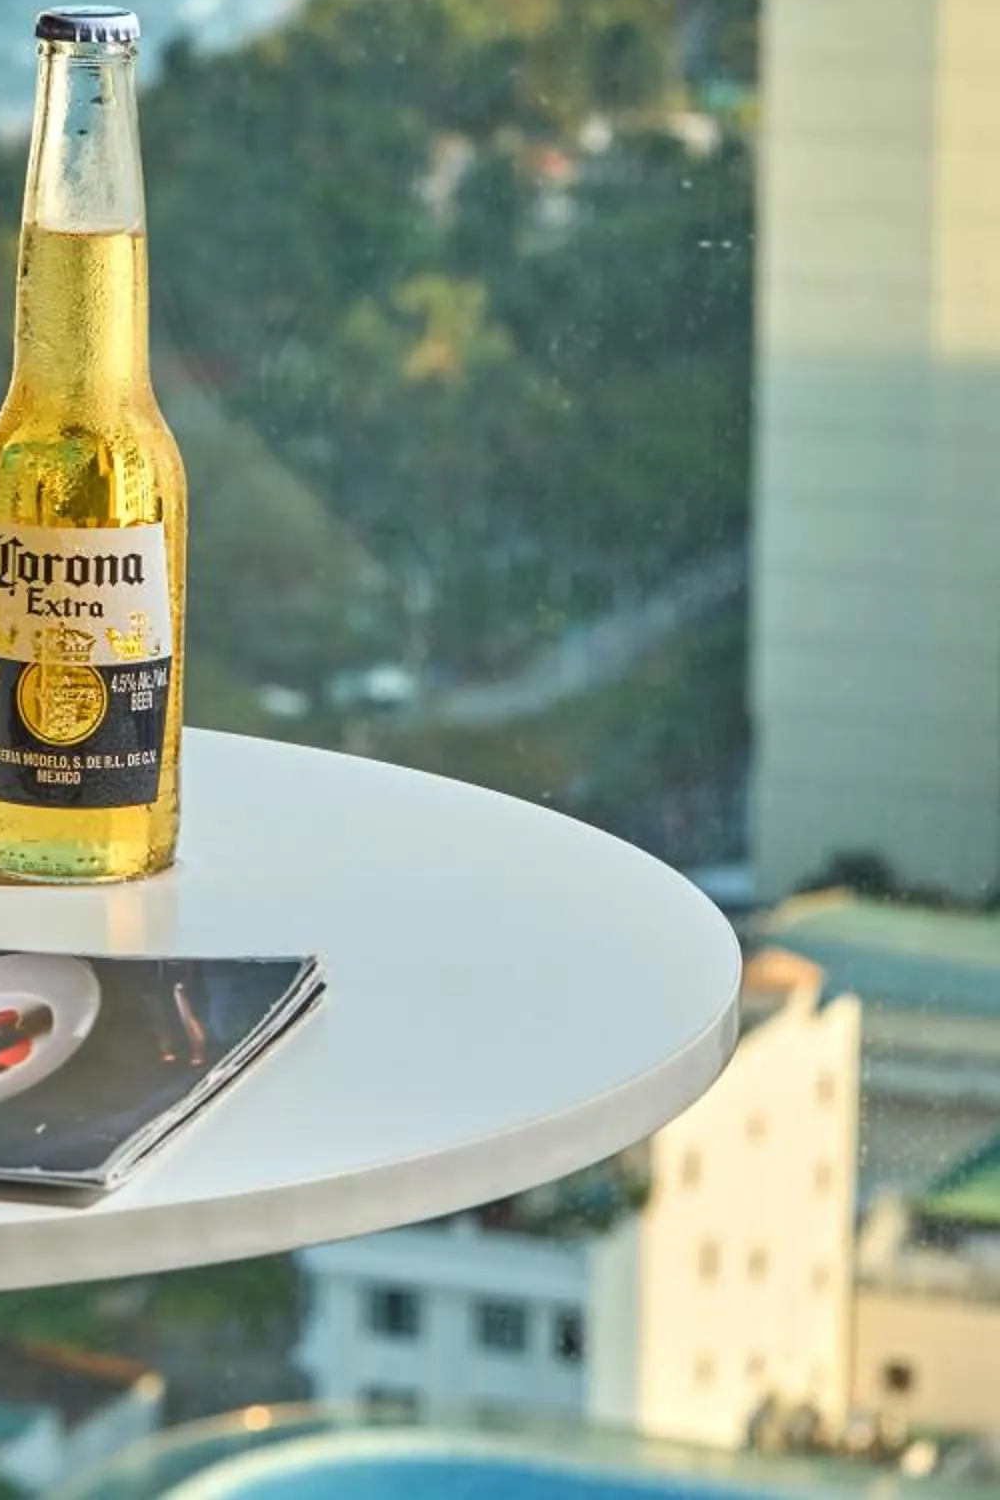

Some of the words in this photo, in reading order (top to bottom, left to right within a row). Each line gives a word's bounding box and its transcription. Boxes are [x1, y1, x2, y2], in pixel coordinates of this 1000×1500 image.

[26, 587, 106, 619] Extra
[130, 690, 154, 712] BEER
[86, 754, 102, 769] DE
[127, 751, 141, 768] DE
[36, 769, 81, 786] MEXICO
